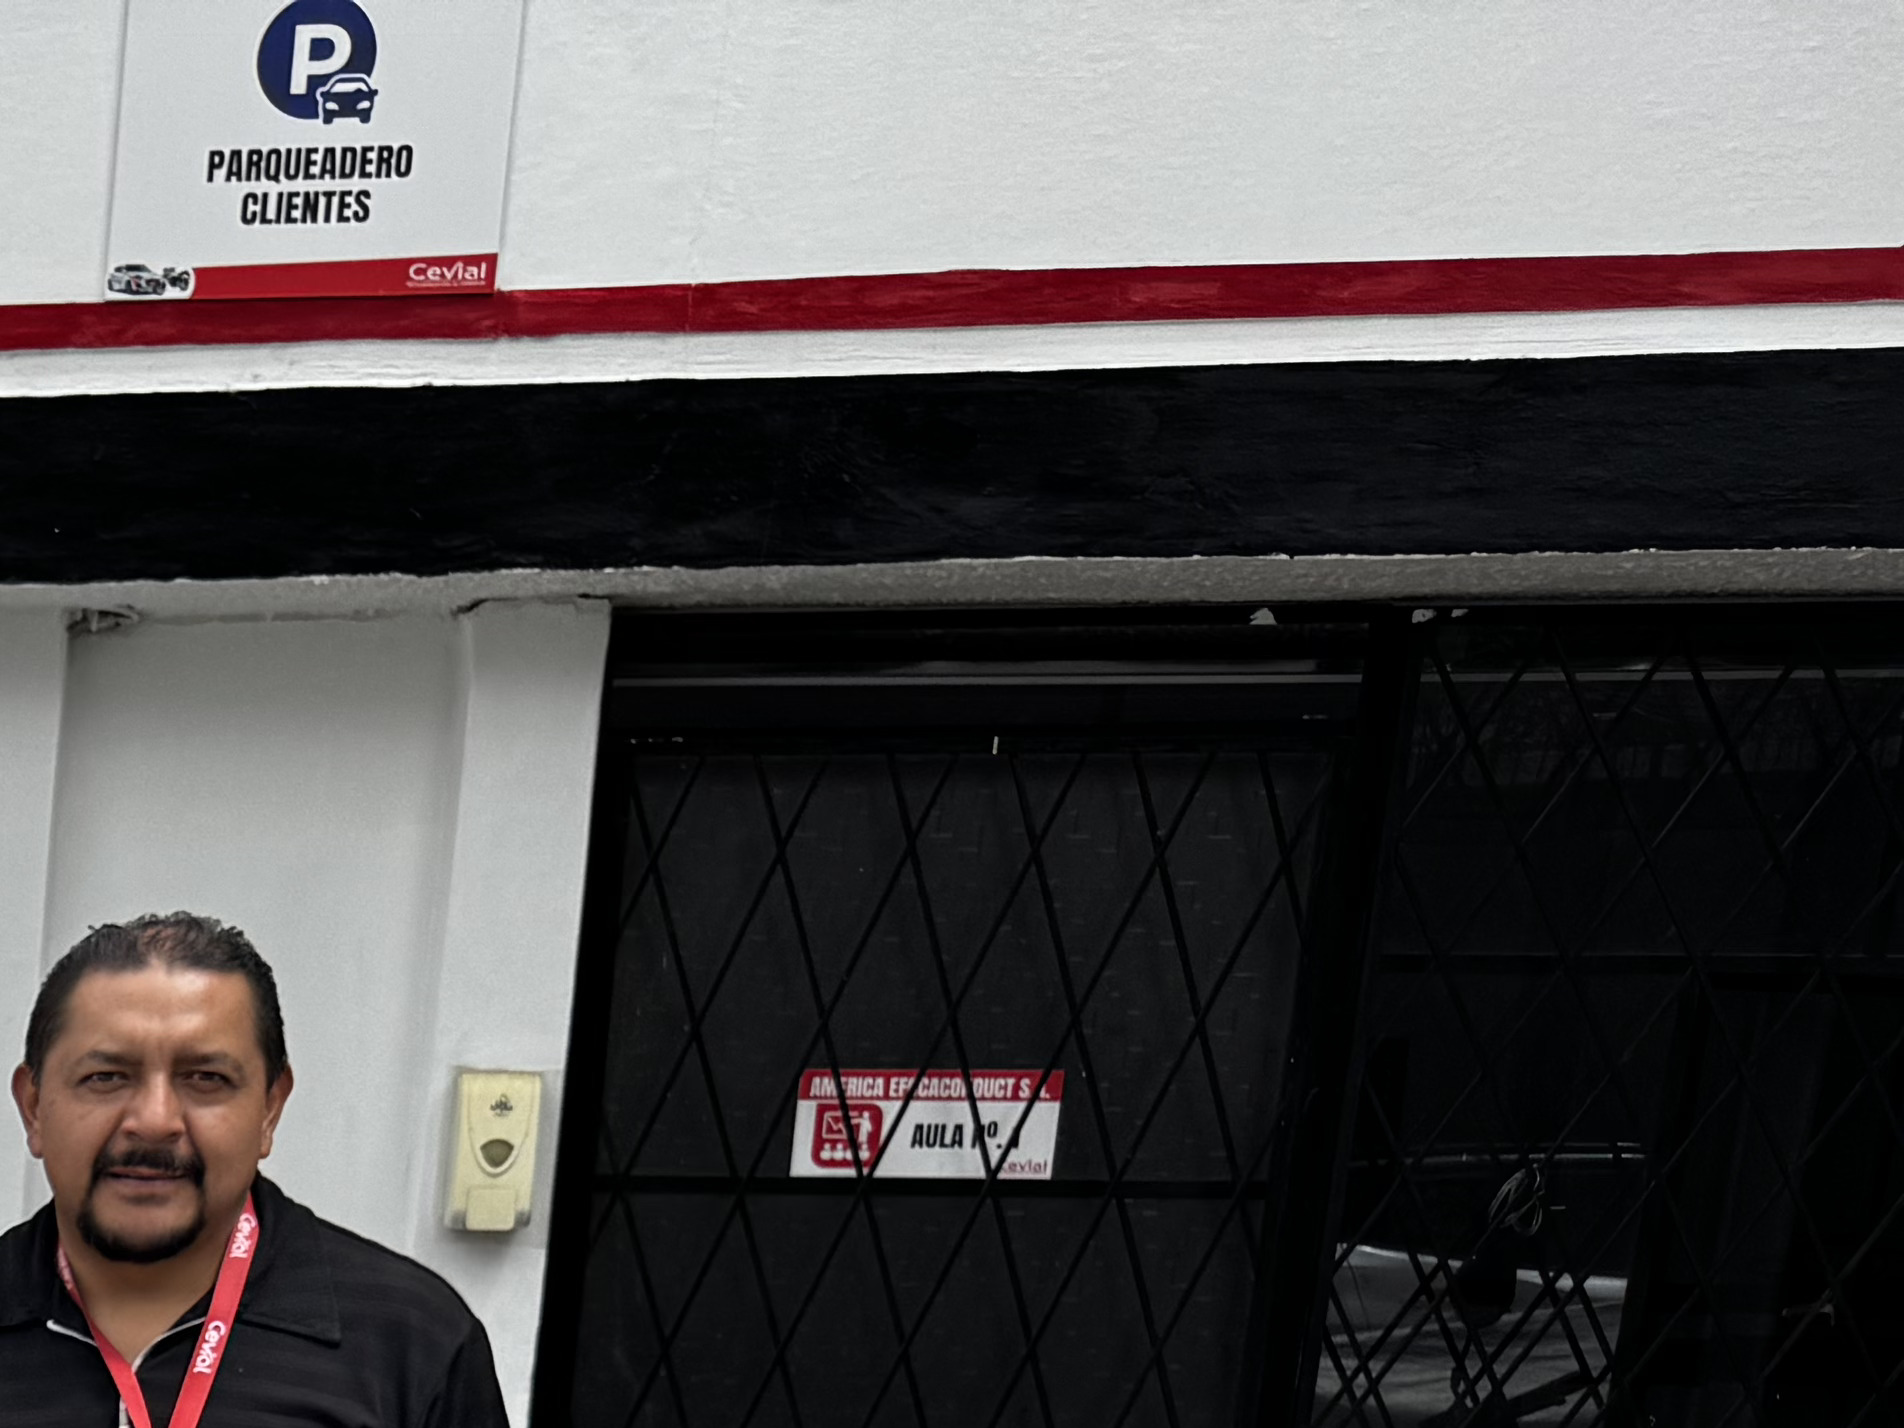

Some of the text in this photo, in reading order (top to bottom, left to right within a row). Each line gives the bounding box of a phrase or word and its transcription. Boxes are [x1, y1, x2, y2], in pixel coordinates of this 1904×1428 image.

[289, 24, 352, 95] P
[206, 144, 414, 183] PARQUEADERO
[240, 189, 372, 226] CLIENTES
[910, 1123, 964, 1149] AULA
[1002, 1159, 1048, 1174] evial
